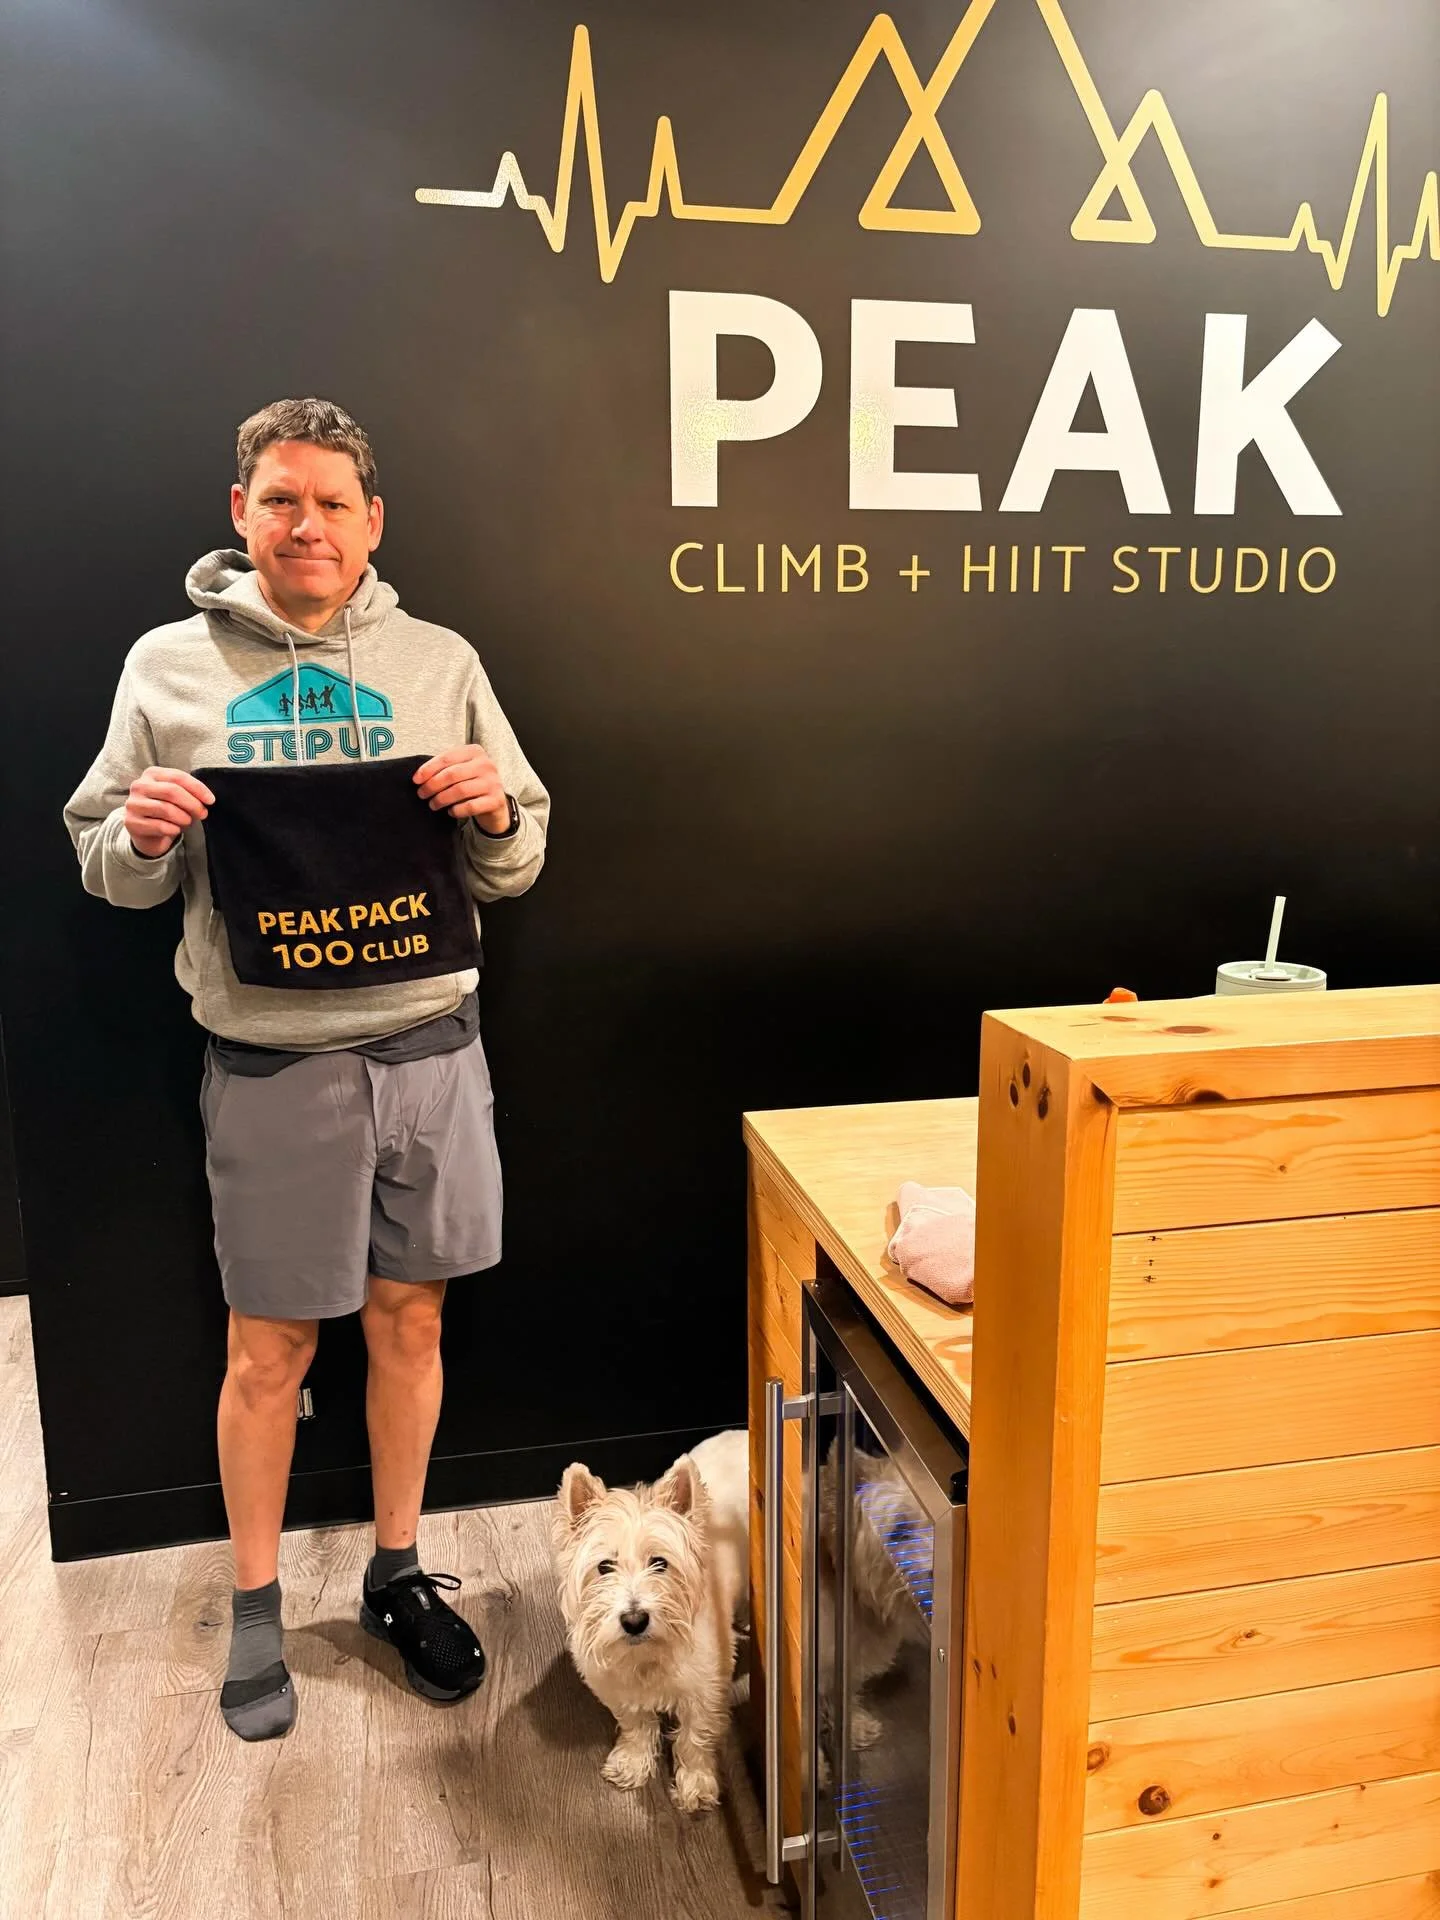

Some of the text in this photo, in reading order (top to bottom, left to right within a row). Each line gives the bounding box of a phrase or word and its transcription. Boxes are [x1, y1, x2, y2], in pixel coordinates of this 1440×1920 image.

[669, 290, 1343, 516] PEAK
[669, 542, 1336, 594] CLIMB + HIIT STUDIO
[227, 727, 394, 764] STEP UP
[257, 892, 431, 936] PEAK PACK
[272, 934, 430, 969] 100 CLUB
